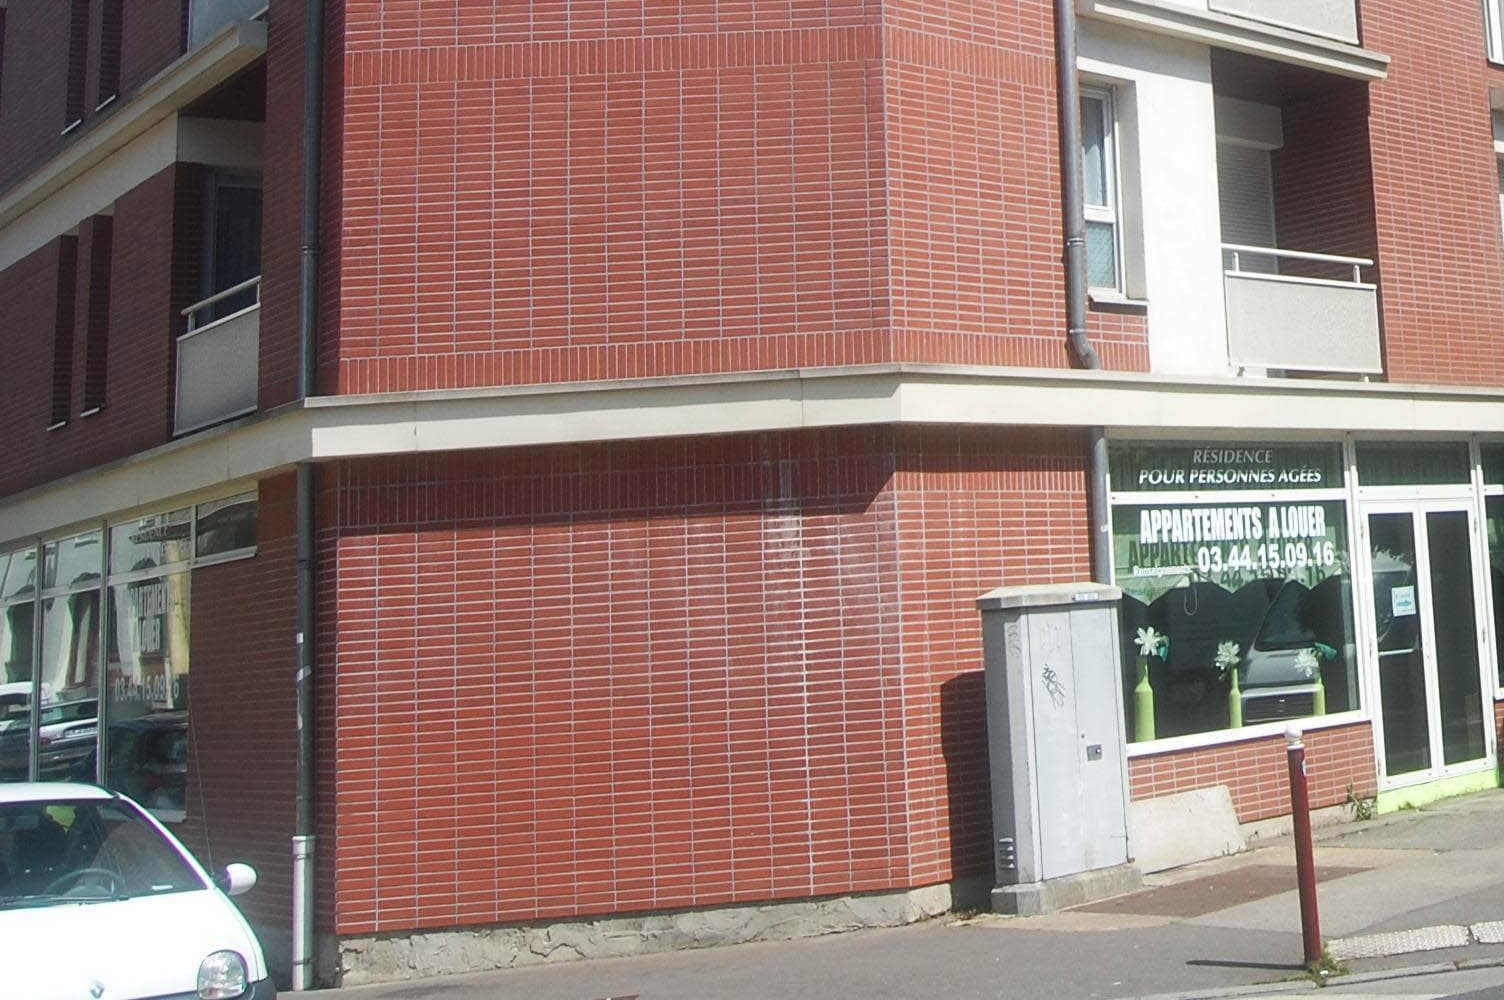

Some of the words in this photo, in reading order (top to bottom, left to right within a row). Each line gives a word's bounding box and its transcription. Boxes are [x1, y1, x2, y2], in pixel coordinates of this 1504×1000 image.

[1193, 445, 1273, 464] RÉSIDENCE
[1138, 468, 1185, 485] POUR
[1188, 467, 1275, 484] PERSONNES
[1278, 464, 1322, 482] AGÉES
[1140, 506, 1263, 544] APPARTEMENTS
[1268, 506, 1280, 539] A
[1280, 505, 1326, 538] LOUER
[1197, 541, 1335, 575] 03.44.15.09.16
